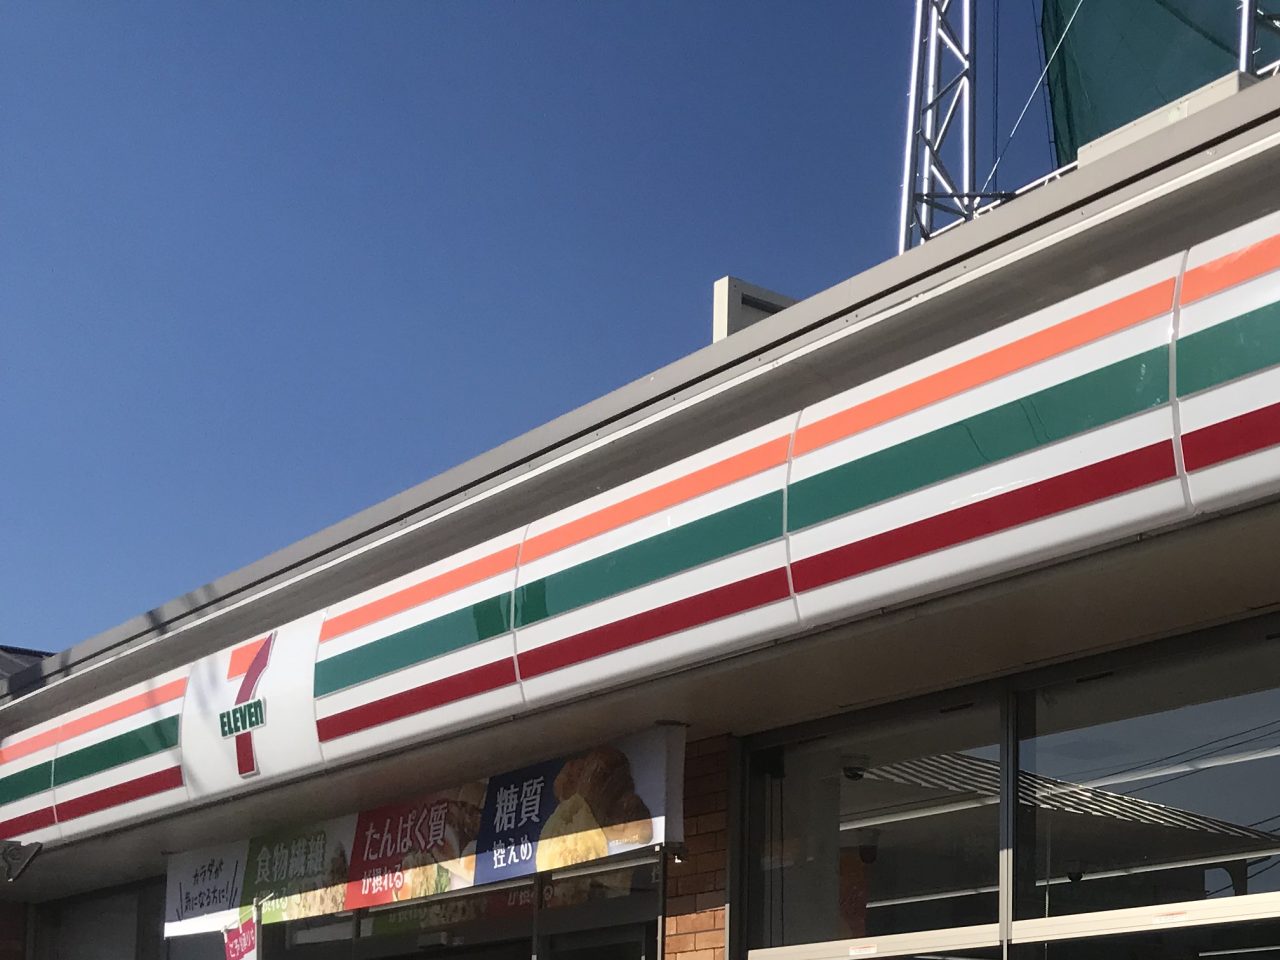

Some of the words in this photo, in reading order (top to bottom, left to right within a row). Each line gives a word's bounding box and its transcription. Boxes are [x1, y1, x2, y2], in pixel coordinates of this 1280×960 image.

[494, 775, 545, 834] 糖質
[362, 802, 449, 862] たんぱく質
[493, 835, 533, 870] 控えめ
[361, 863, 405, 896] が摂れる
